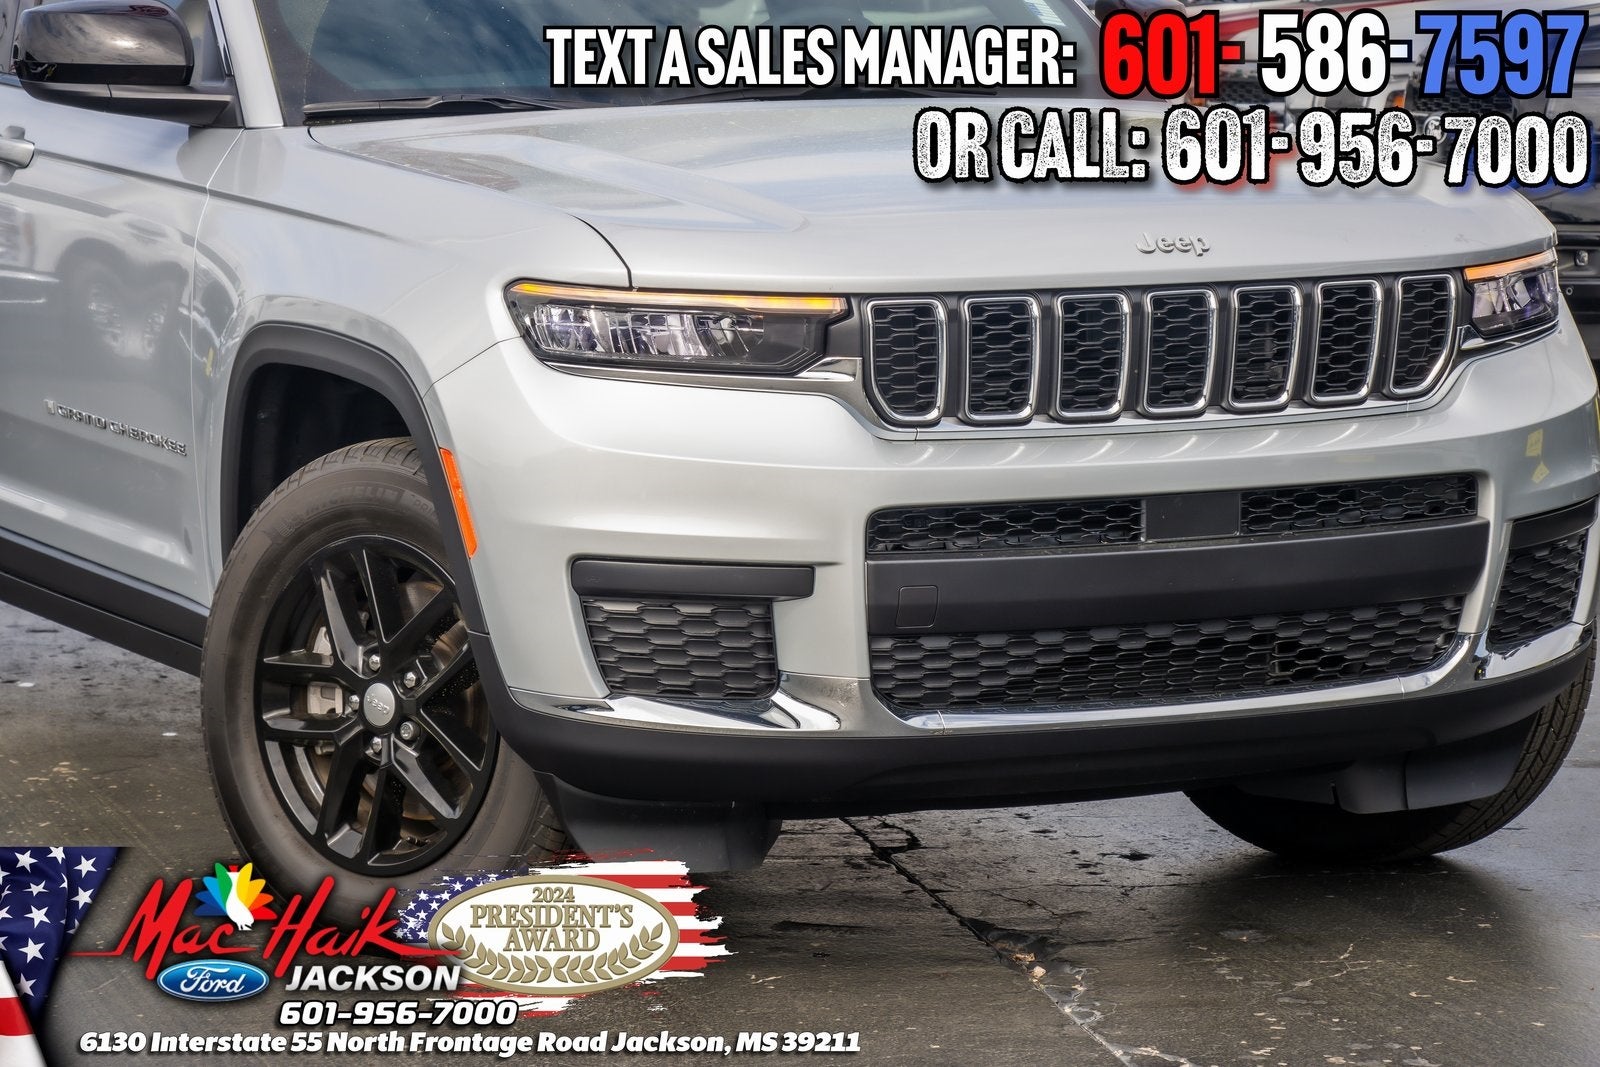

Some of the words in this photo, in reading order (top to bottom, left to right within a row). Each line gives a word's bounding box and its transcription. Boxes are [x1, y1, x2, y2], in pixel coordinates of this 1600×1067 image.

[1136, 232, 1210, 257] Jeep
[56, 404, 108, 430] GRAND
[109, 420, 188, 457] CHEROKEE
[366, 693, 391, 716] Jeep
